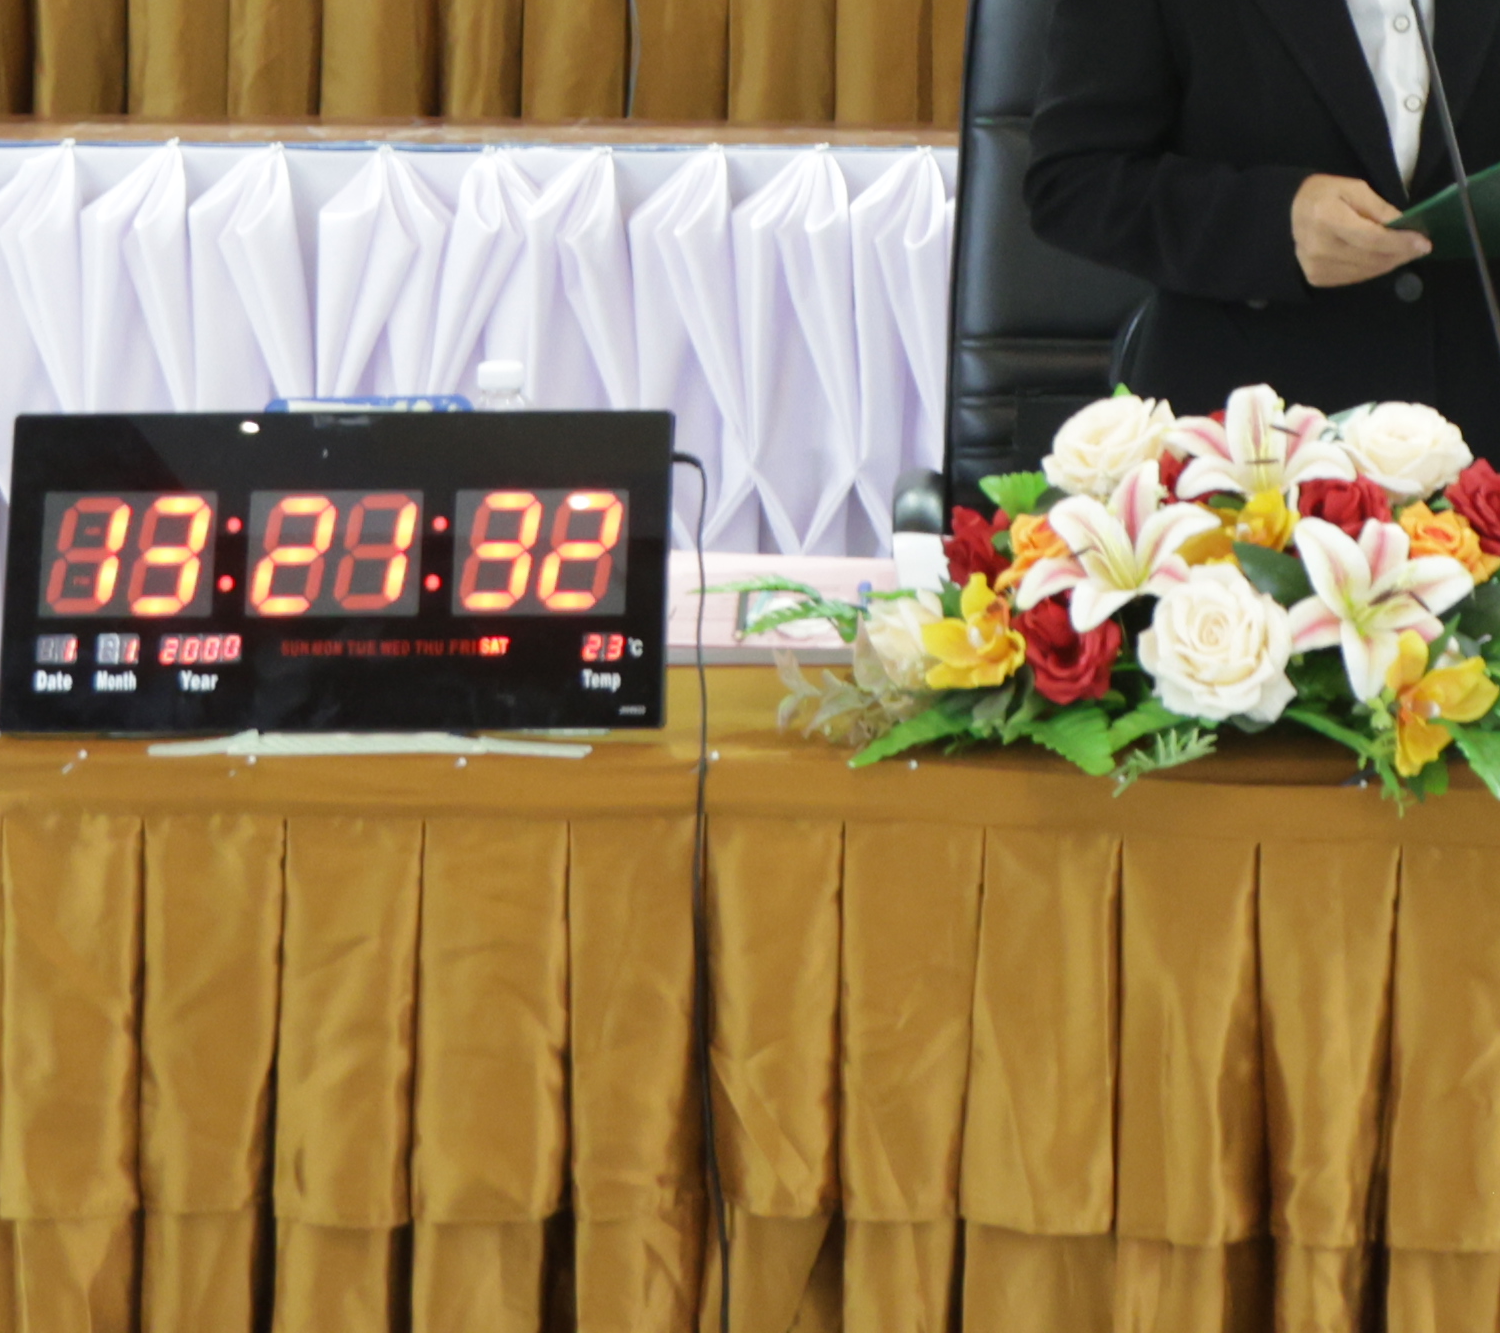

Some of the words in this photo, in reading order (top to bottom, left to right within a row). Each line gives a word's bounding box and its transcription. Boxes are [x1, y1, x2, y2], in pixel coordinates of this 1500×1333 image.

[158, 633, 242, 666] 2000
[479, 636, 510, 656] SAT
[581, 632, 626, 663] 23
[33, 670, 73, 692] Date
[94, 670, 137, 692] Month
[178, 670, 219, 692] Year
[581, 669, 622, 693] Temp
